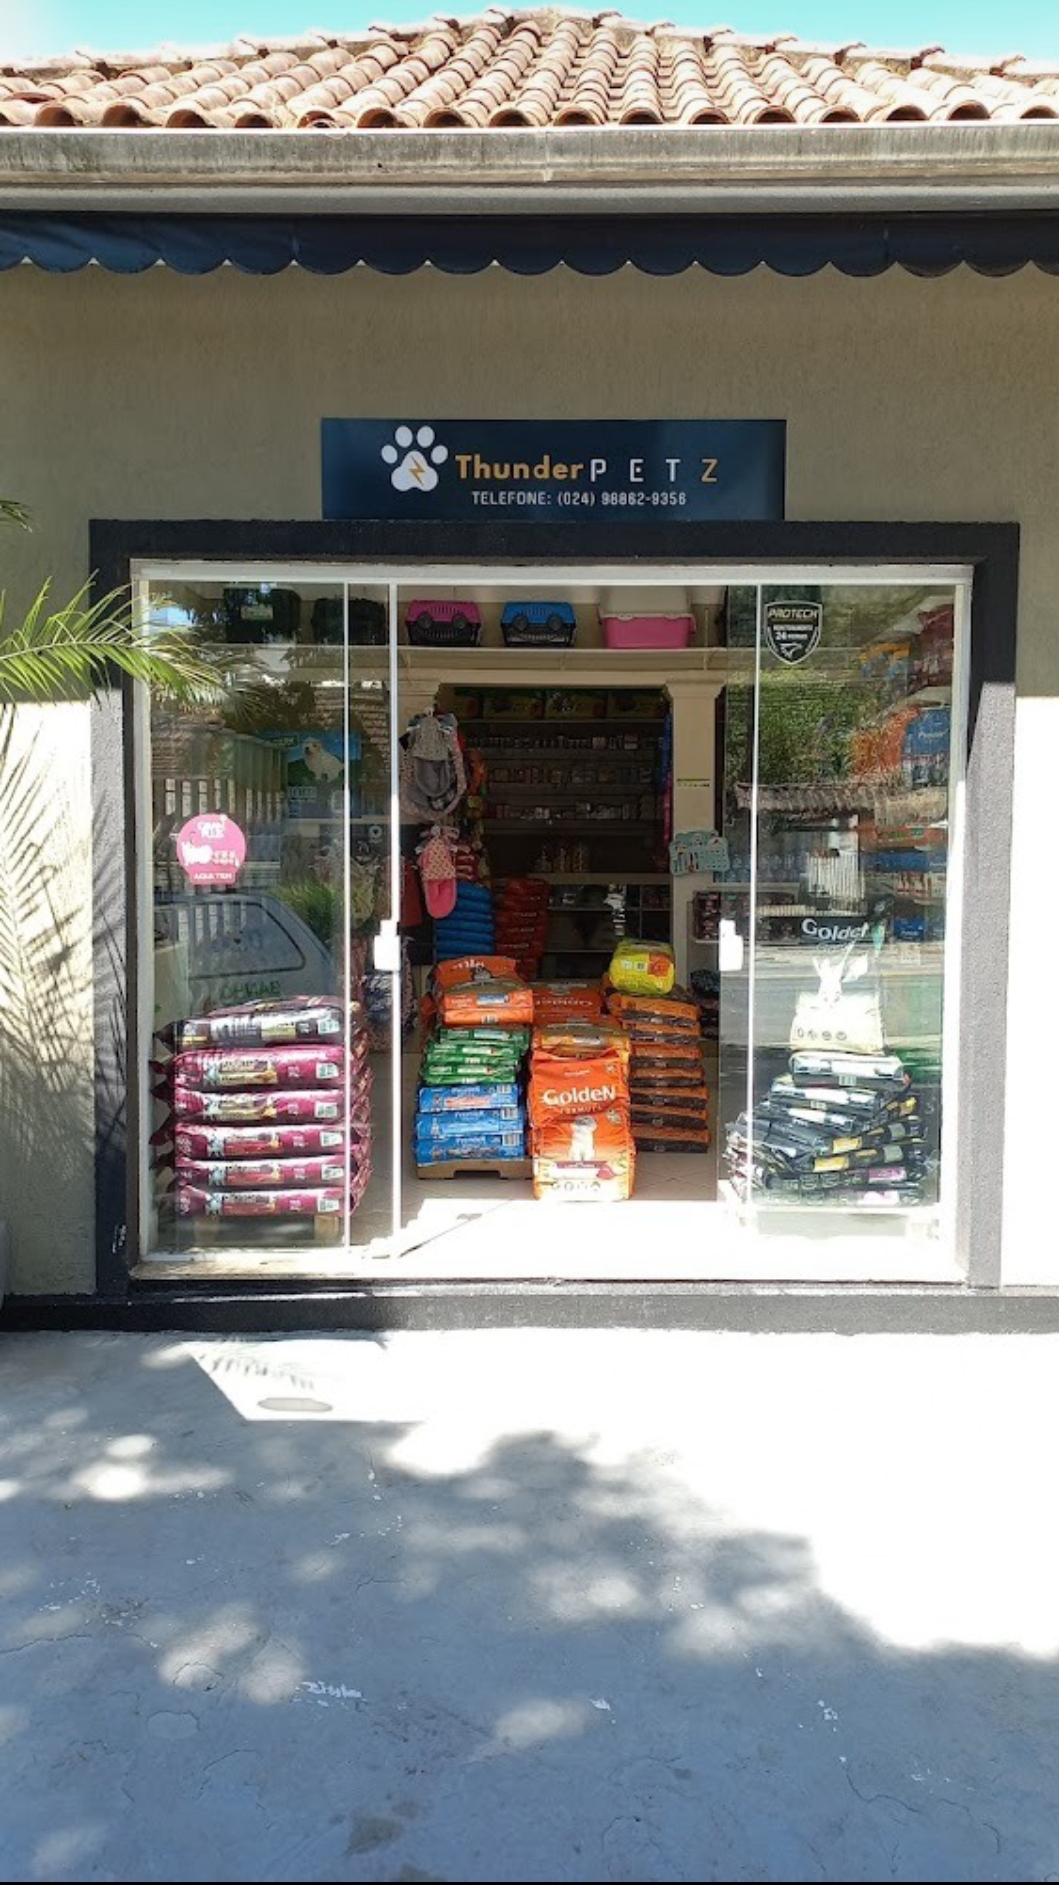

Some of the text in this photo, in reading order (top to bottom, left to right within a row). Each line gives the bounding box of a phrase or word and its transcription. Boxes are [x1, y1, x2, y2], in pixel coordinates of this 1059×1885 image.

[455, 453, 584, 480] Thunder
[471, 490, 551, 506] TELEFONE:
[557, 490, 596, 507] (024)
[767, 609, 818, 619] PROTECH
[775, 631, 787, 640] 24
